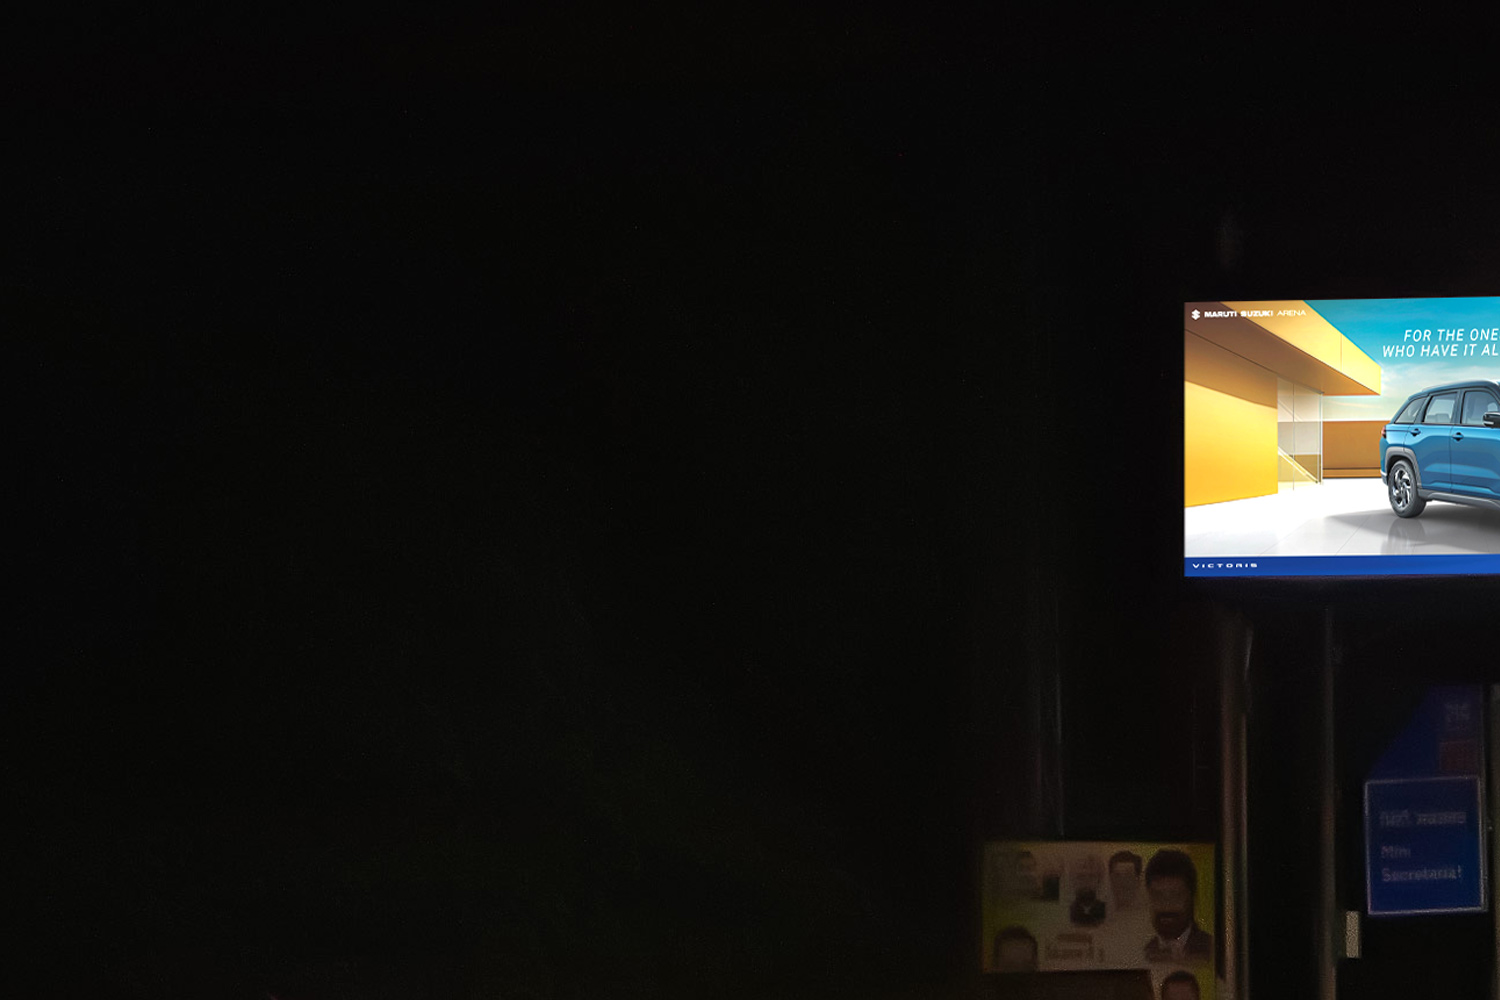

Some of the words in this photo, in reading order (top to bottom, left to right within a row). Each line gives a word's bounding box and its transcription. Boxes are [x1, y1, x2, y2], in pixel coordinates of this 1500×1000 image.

[1404, 329, 1431, 342] FOR
[1437, 328, 1464, 341] THE
[1383, 344, 1415, 357] WHO
[1420, 344, 1458, 357] HAVE
[1464, 343, 1477, 356] IT
